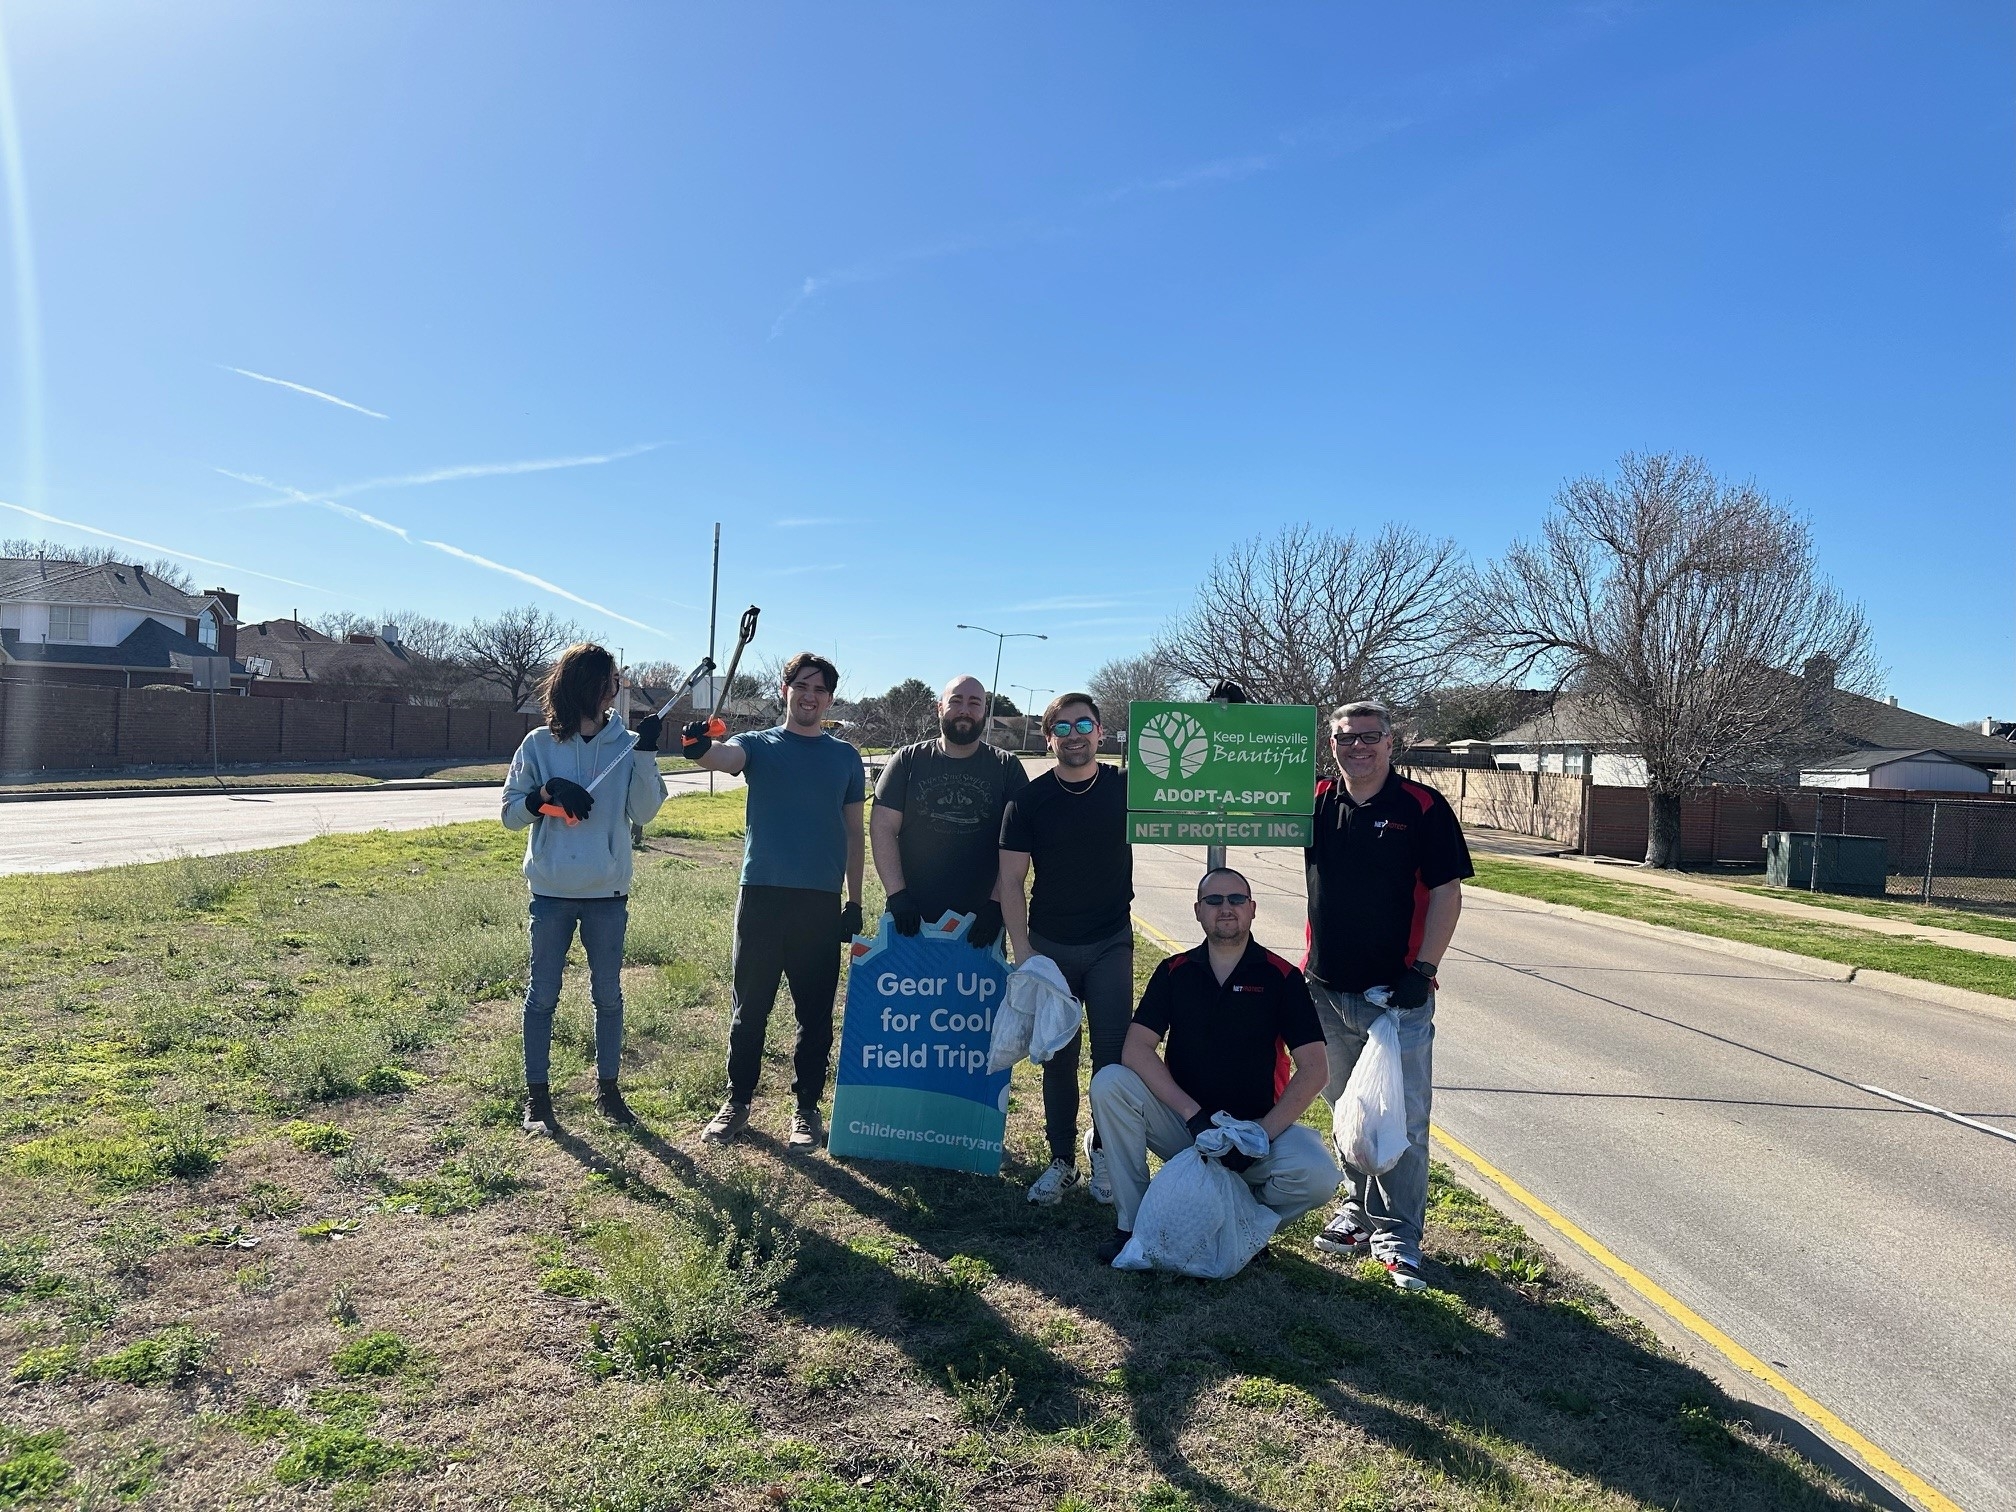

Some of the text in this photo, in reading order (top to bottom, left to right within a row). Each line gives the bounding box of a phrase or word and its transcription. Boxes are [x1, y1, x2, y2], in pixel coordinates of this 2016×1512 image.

[1213, 731, 1308, 745] Keep Lewisville
[1213, 744, 1308, 775] Beautiful
[1153, 788, 1291, 805] ADOPT-A-SPOT
[1135, 823, 1305, 838] NET PROTECT INC.
[877, 972, 997, 1002] Gear Up
[880, 1007, 991, 1032] for Cool
[862, 1043, 928, 1068] Field
